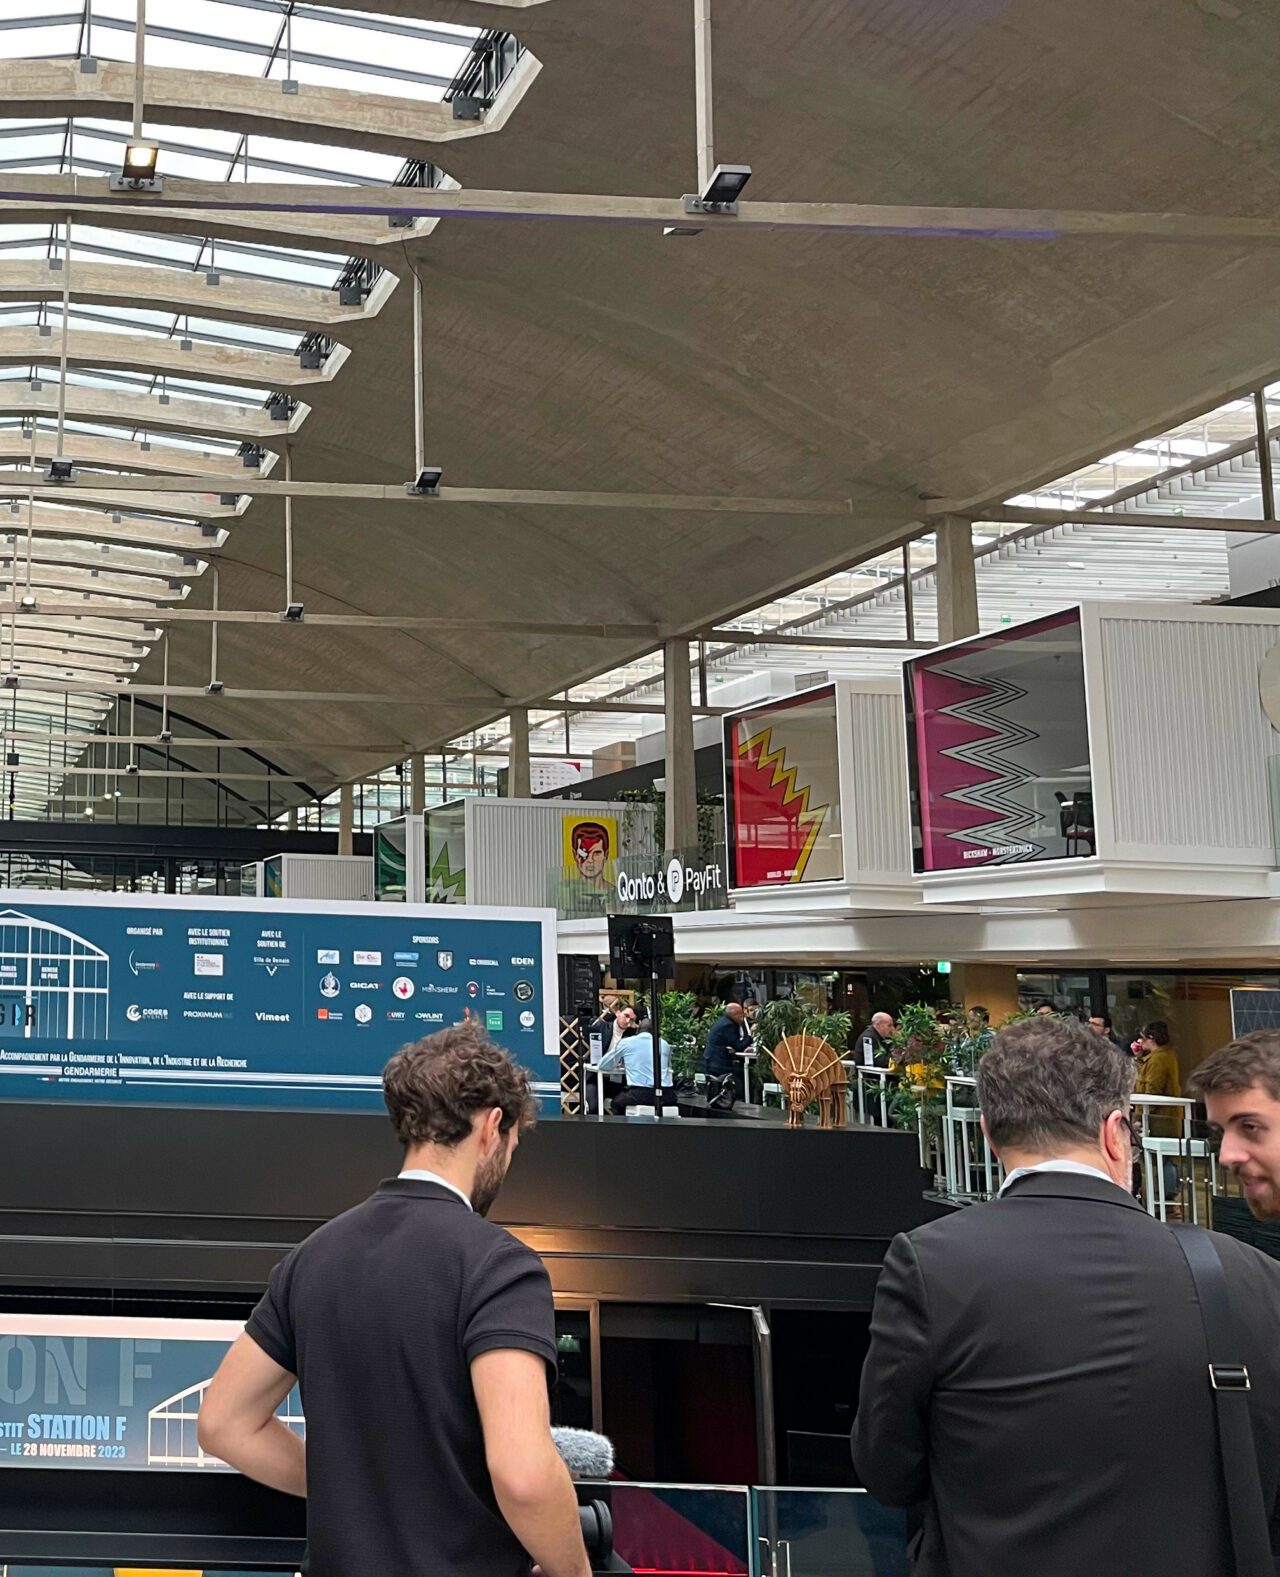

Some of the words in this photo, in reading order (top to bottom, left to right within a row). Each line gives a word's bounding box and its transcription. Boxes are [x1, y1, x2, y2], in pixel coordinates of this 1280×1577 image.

[618, 872, 655, 901] Qonto
[657, 871, 665, 894] &
[686, 864, 721, 895] PayFit
[511, 957, 534, 965] EDEN
[198, 992, 204, 1000] LE
[226, 993, 234, 1001] DE
[61, 1053, 68, 1062] LA
[106, 1055, 114, 1064] DE
[152, 1056, 160, 1065] DE
[201, 1058, 208, 1067] DE
[209, 1058, 216, 1067] LA
[64, 1067, 117, 1077] GENDARMERIE
[119, 1338, 161, 1407] F
[27, 1413, 110, 1441] STATION
[115, 1416, 127, 1441] F
[10, 1443, 22, 1456] LE
[23, 1443, 37, 1457] 28
[39, 1443, 97, 1458] NOVEMBRE
[98, 1445, 125, 1458] 2023
